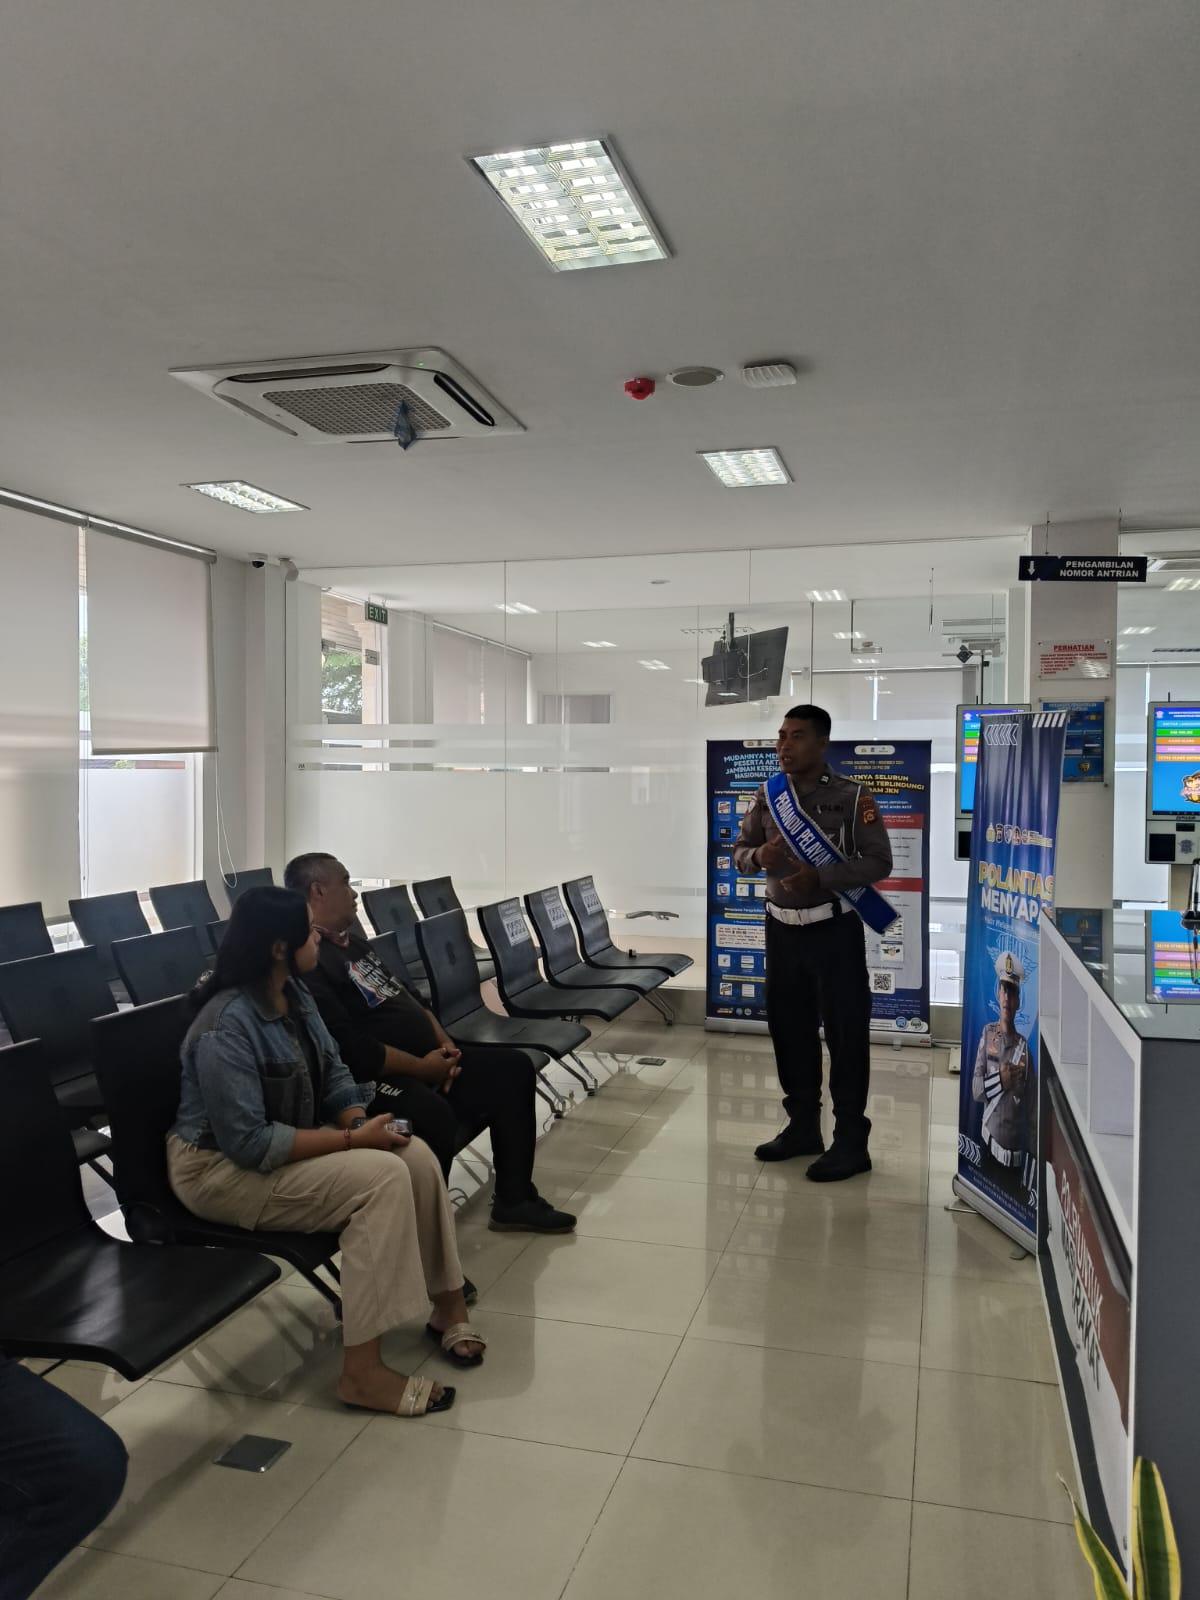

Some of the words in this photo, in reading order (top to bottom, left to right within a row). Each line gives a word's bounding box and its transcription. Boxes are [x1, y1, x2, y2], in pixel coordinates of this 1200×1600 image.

[1065, 560, 1134, 569] PENGAMBILAN
[1059, 569, 1095, 577] NOMOR
[1096, 569, 1139, 578] ANTRIAN
[369, 606, 387, 623] EXIT
[1053, 644, 1095, 652] PERHATIAN
[723, 753, 764, 763] MUDAHNYA
[733, 759, 764, 767] PESERTA
[725, 766, 756, 775] JAMINAN
[734, 771, 768, 780] NASIONAL
[874, 774, 909, 782] SELURUH
[876, 780, 925, 791] TERLINDUNGI
[774, 790, 806, 834] PEMANDU
[978, 860, 1055, 901] POLANTAS
[376, 1082, 403, 1097] TEAM
[1077, 1222, 1103, 1341] UNTUK
